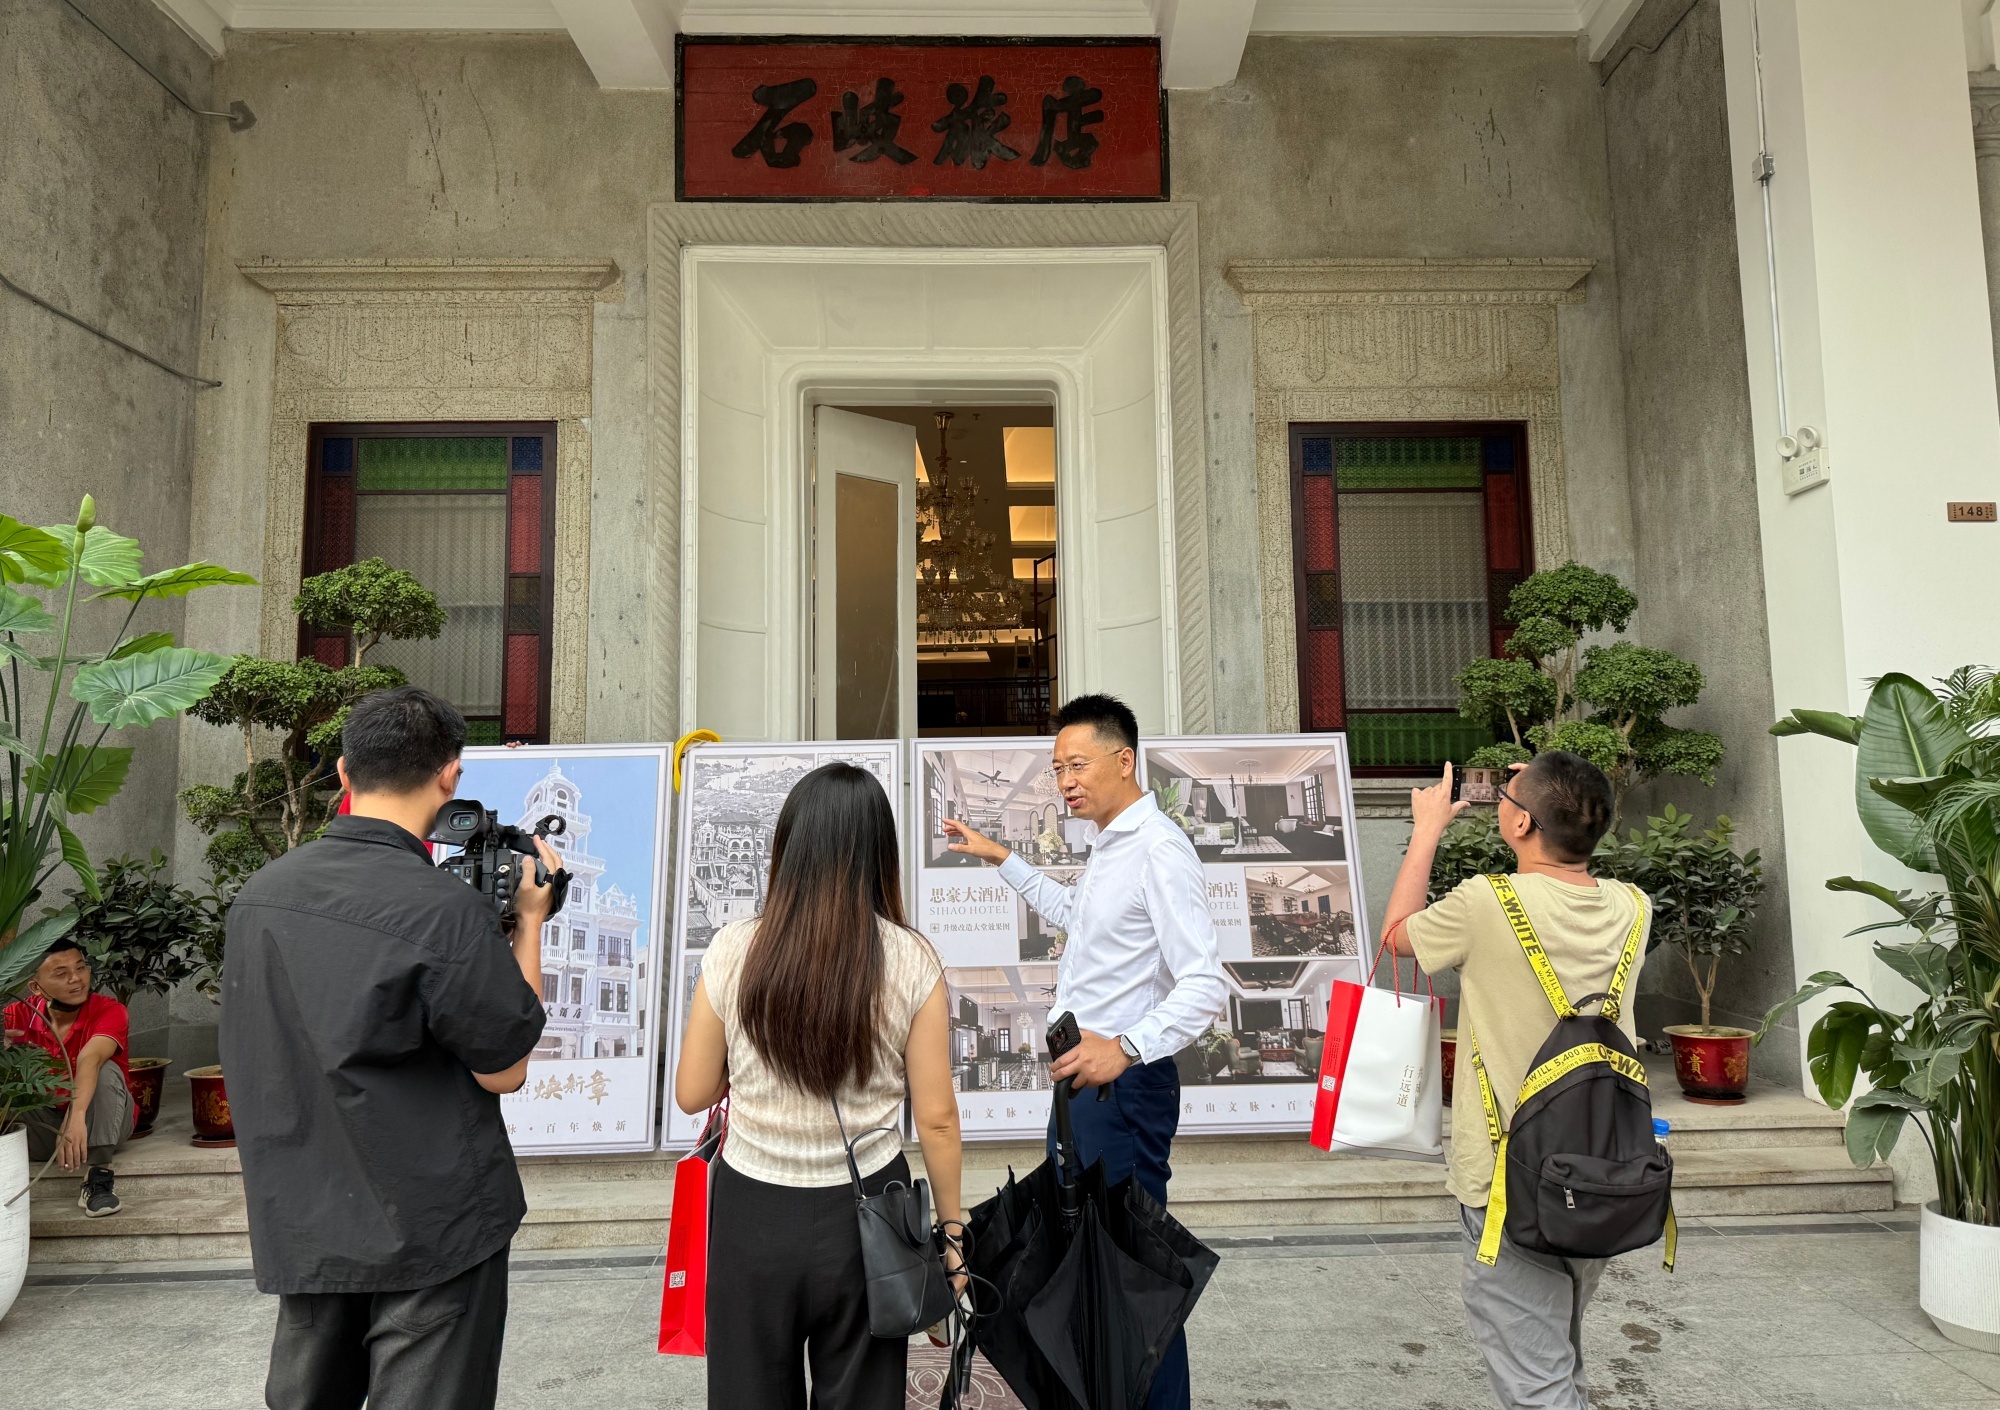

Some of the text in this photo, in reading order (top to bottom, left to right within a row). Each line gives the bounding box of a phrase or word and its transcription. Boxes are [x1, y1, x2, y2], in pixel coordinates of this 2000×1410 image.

[732, 76, 1105, 169] 石岐旅店
[1958, 506, 1983, 516] 148
[929, 886, 1009, 903] 思豪大酒店
[1207, 882, 1238, 898] 酒店
[929, 905, 1009, 916] SIHAO HOTEL
[1209, 901, 1239, 910] OTEL
[943, 923, 1010, 932] 升级改造大堂效果图
[1529, 1064, 1552, 1082] WILL
[1554, 1049, 1581, 1067] 5,400
[1580, 1045, 1596, 1055] lbs
[1686, 1053, 1704, 1075] 貴
[1531, 1075, 1554, 1091] Weight
[1552, 1059, 1580, 1079] Securing
[533, 1069, 612, 1106] 焕新章
[1396, 1064, 1415, 1108] 行远道
